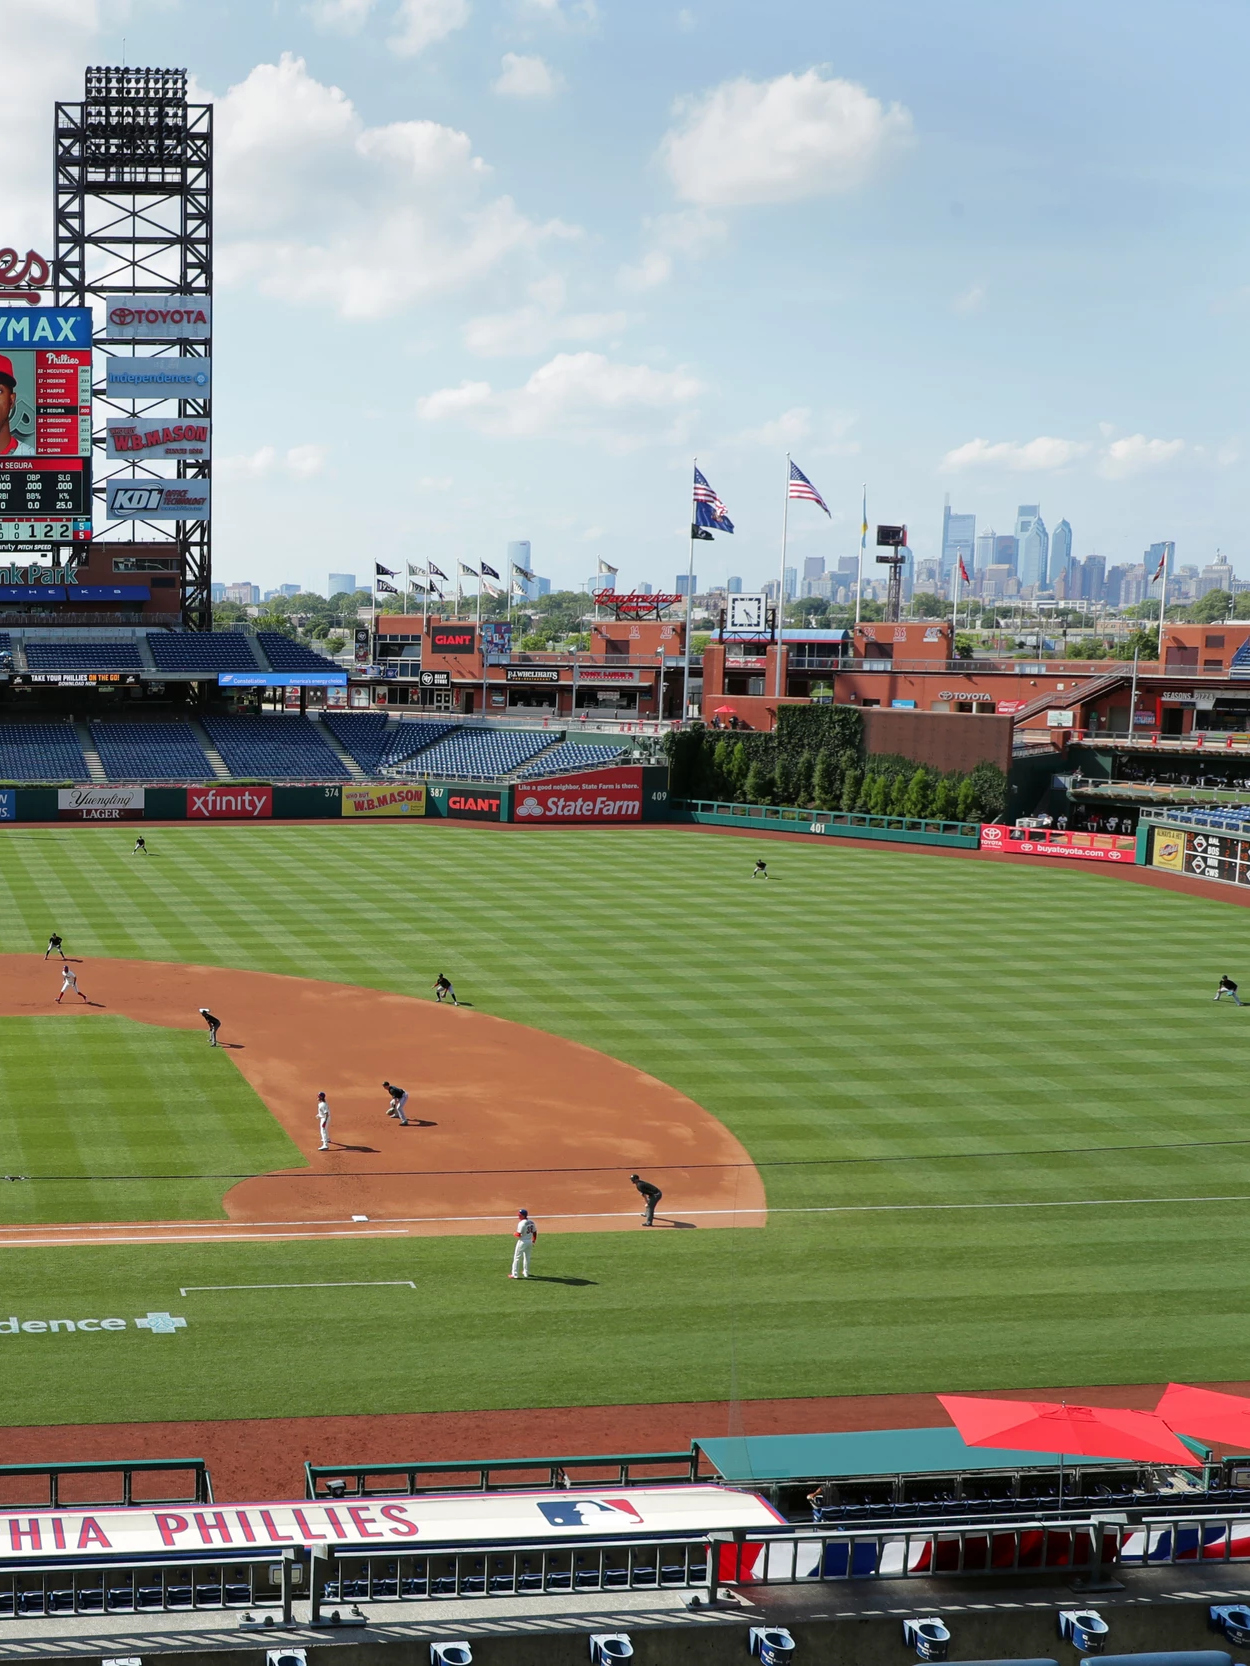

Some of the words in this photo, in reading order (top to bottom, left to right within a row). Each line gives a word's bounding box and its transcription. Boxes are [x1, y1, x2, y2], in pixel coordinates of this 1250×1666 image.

[134, 309, 207, 324] TOYOTA
[46, 352, 80, 364] Phillies
[108, 372, 191, 386] Independence
[165, 489, 189, 498] OFFICE
[163, 497, 208, 506] TECHNOLOGY
[44, 524, 54, 538] 2
[59, 524, 70, 538] 2
[27, 562, 79, 585] Park
[591, 587, 683, 606] Budweiser
[893, 627, 907, 637] 36
[435, 635, 472, 645] GIANT
[31, 674, 45, 682] TAKE
[47, 674, 61, 682] YOUR
[953, 692, 991, 701] TOYOTA
[1162, 691, 1192, 699] SEASONS
[1193, 692, 1215, 700] PIZZA
[68, 789, 134, 808] Yuengling
[324, 788, 339, 798] 374
[430, 788, 444, 798] 387
[651, 791, 668, 802] 409
[192, 789, 268, 816] xfinity
[448, 796, 500, 812] GIANT
[82, 809, 120, 819] LAGER
[810, 823, 825, 834] 401
[1157, 829, 1171, 839] ALWAYS
[1175, 832, 1183, 840] HIT
[1208, 836, 1221, 846] BAL
[1036, 844, 1104, 857] buyatoyota.com
[1207, 846, 1220, 856] BOS
[1206, 857, 1219, 867] MIN
[1204, 867, 1219, 878] CWS
[155, 1504, 420, 1546] PHILLIES
